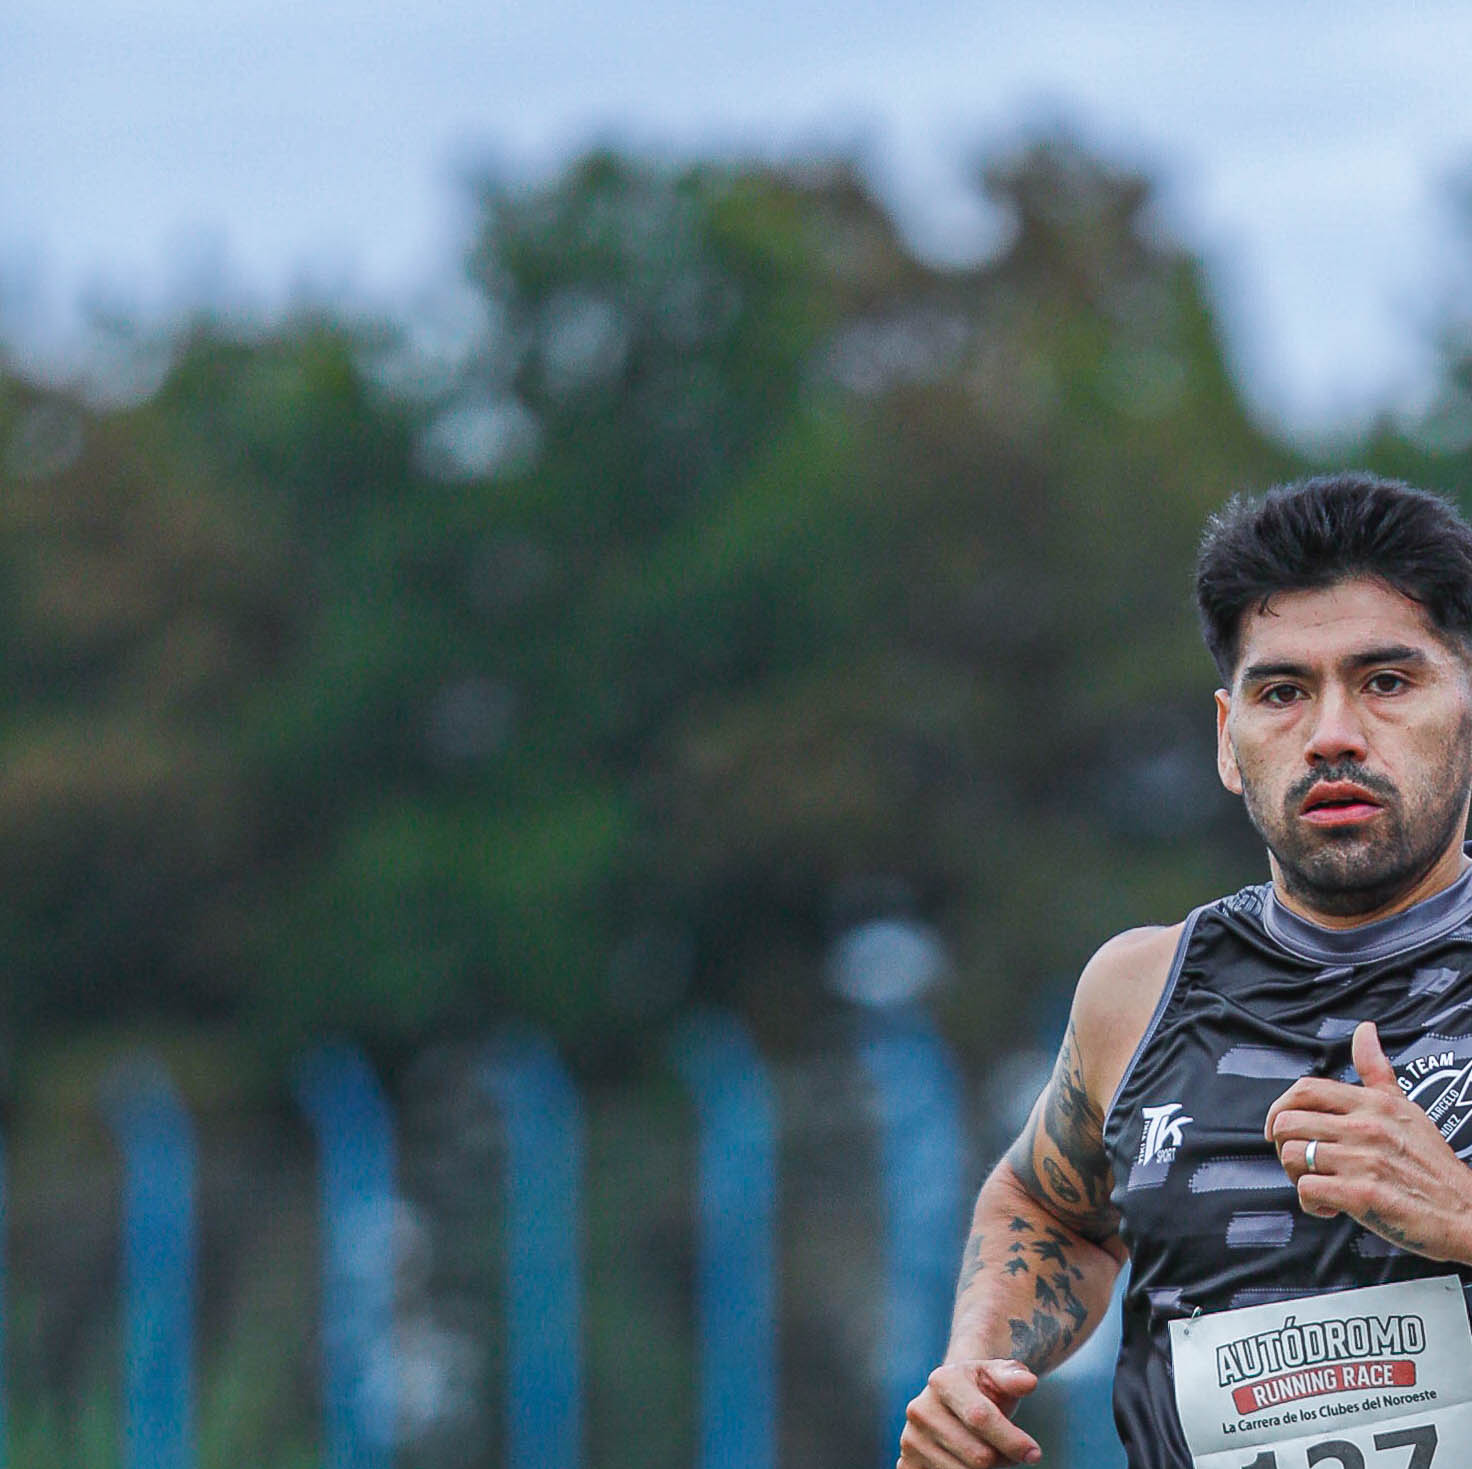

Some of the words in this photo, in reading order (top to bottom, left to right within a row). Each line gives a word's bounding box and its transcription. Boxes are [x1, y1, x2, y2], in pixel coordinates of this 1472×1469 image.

[1406, 1051, 1454, 1079] TEAM
[1156, 1147, 1176, 1163] SPORT
[1216, 1315, 1426, 1387] AUTÓDROMO
[1252, 1368, 1337, 1409] RUNNING
[1343, 1364, 1394, 1388] RACE
[1222, 1422, 1237, 1435] La
[1238, 1417, 1280, 1432] Carrera
[1283, 1411, 1299, 1424] de
[1300, 1408, 1317, 1422] los
[1319, 1402, 1359, 1418] Clubes
[1362, 1396, 1382, 1410] del
[1384, 1389, 1438, 1408] Noroeste
